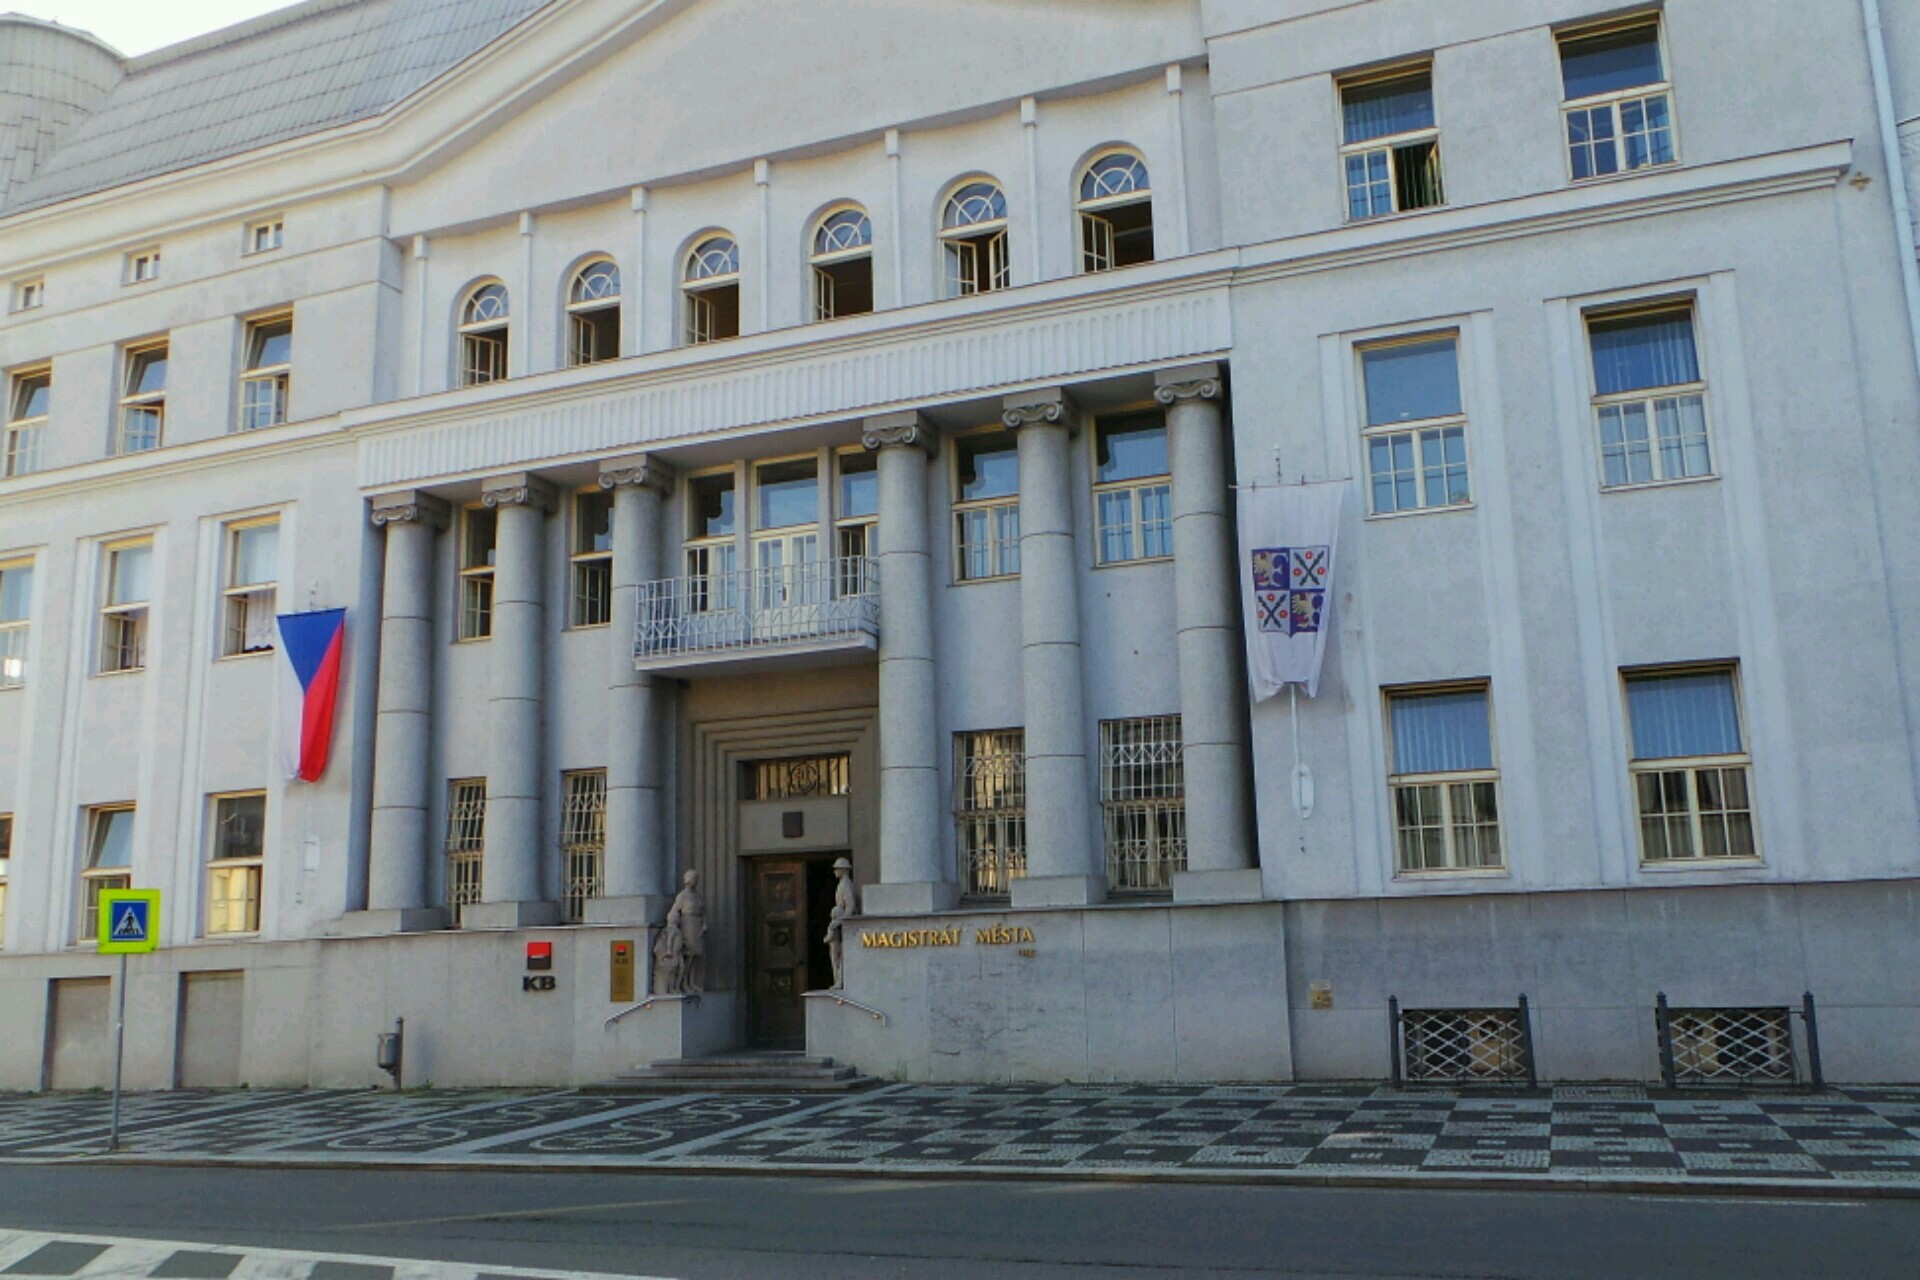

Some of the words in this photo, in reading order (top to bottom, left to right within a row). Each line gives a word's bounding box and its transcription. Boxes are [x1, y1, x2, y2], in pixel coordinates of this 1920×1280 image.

[862, 924, 962, 948] MAGISTRÁT
[976, 921, 1035, 945] MĚSTA
[523, 975, 556, 991] KB
